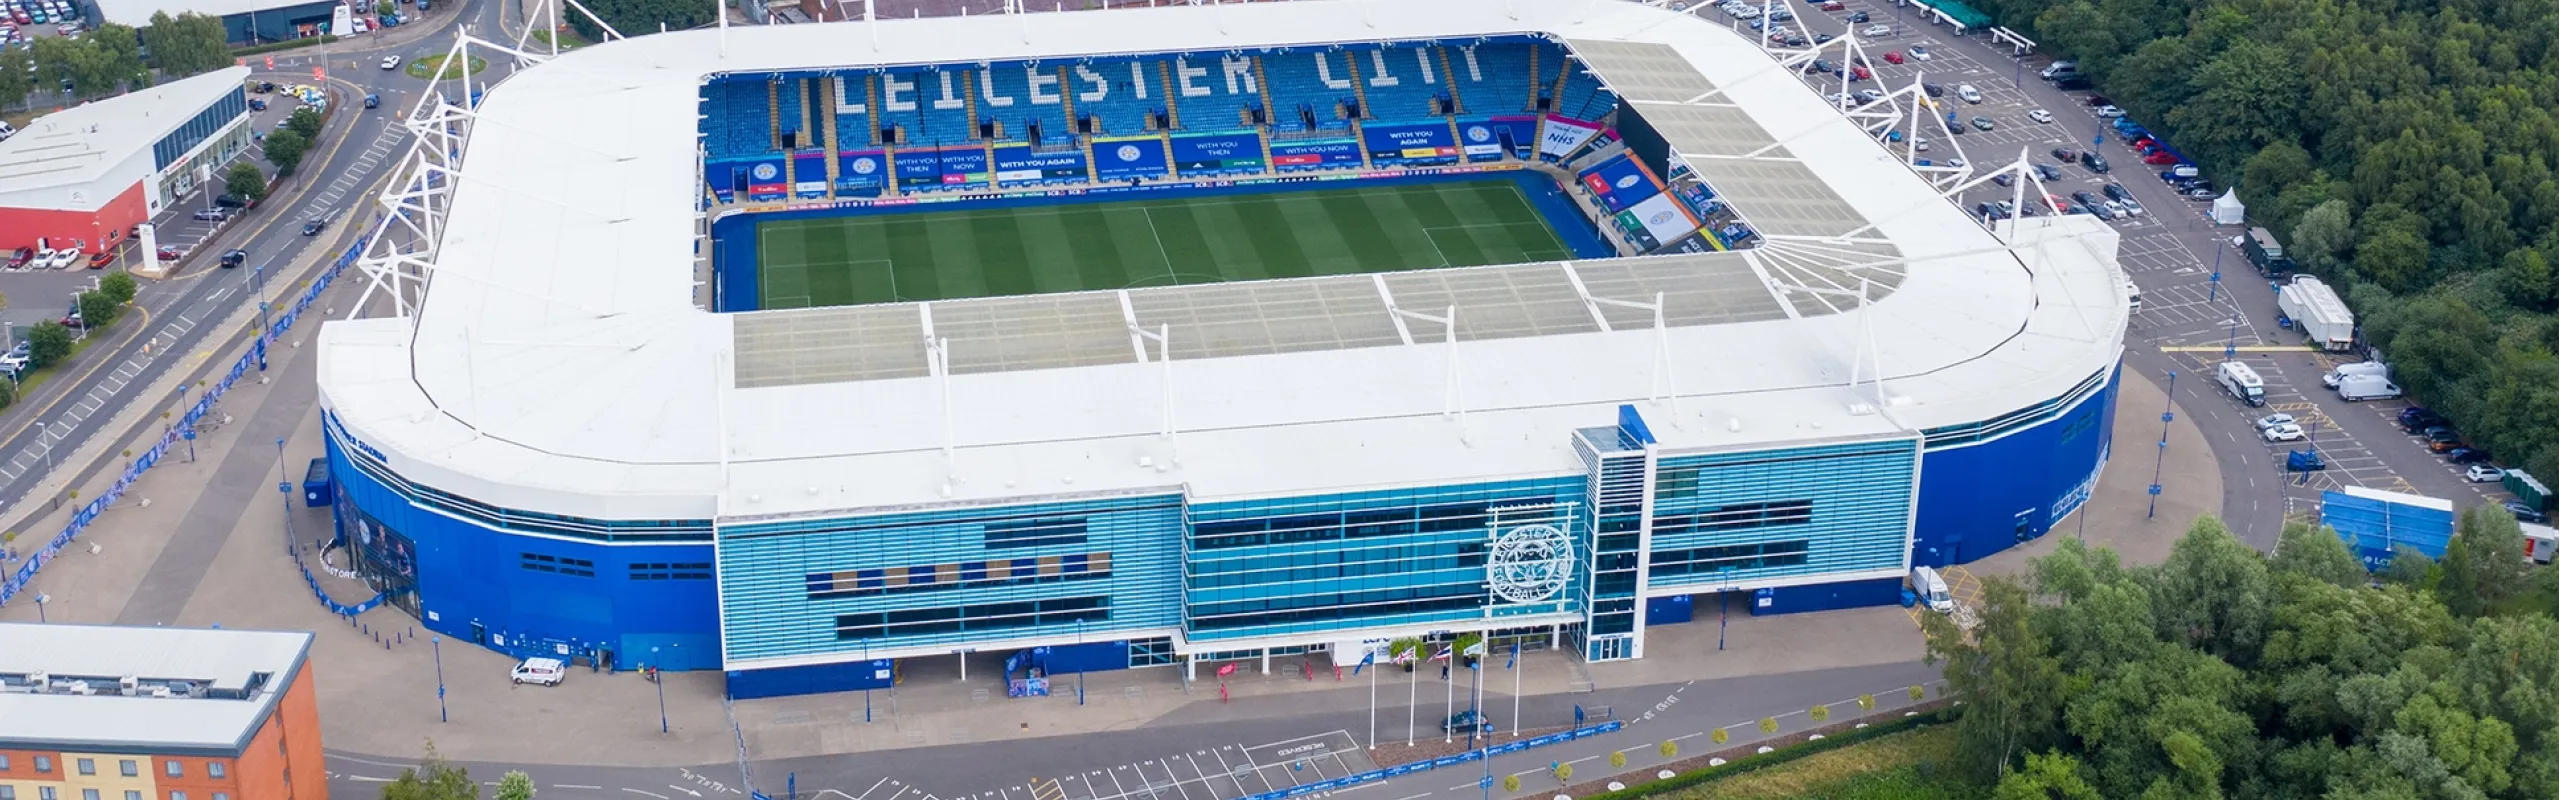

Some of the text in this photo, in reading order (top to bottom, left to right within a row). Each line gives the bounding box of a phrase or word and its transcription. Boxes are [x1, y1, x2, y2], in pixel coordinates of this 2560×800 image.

[834, 45, 1483, 115] LEICESTER CITY
[1400, 138, 1428, 146] AGAIN
[1548, 132, 1576, 146] NHS
[1196, 142, 1219, 150] WITH
[1207, 148, 1231, 157] THEN
[1285, 147, 1308, 155] WITH
[896, 156, 938, 166] WITH YOU
[941, 154, 985, 163] WITH YOU
[1000, 157, 1076, 169] WITH YOU AGAIN
[905, 165, 930, 173] THEN
[952, 162, 976, 171] NOW
[330, 567, 357, 580] STORE
